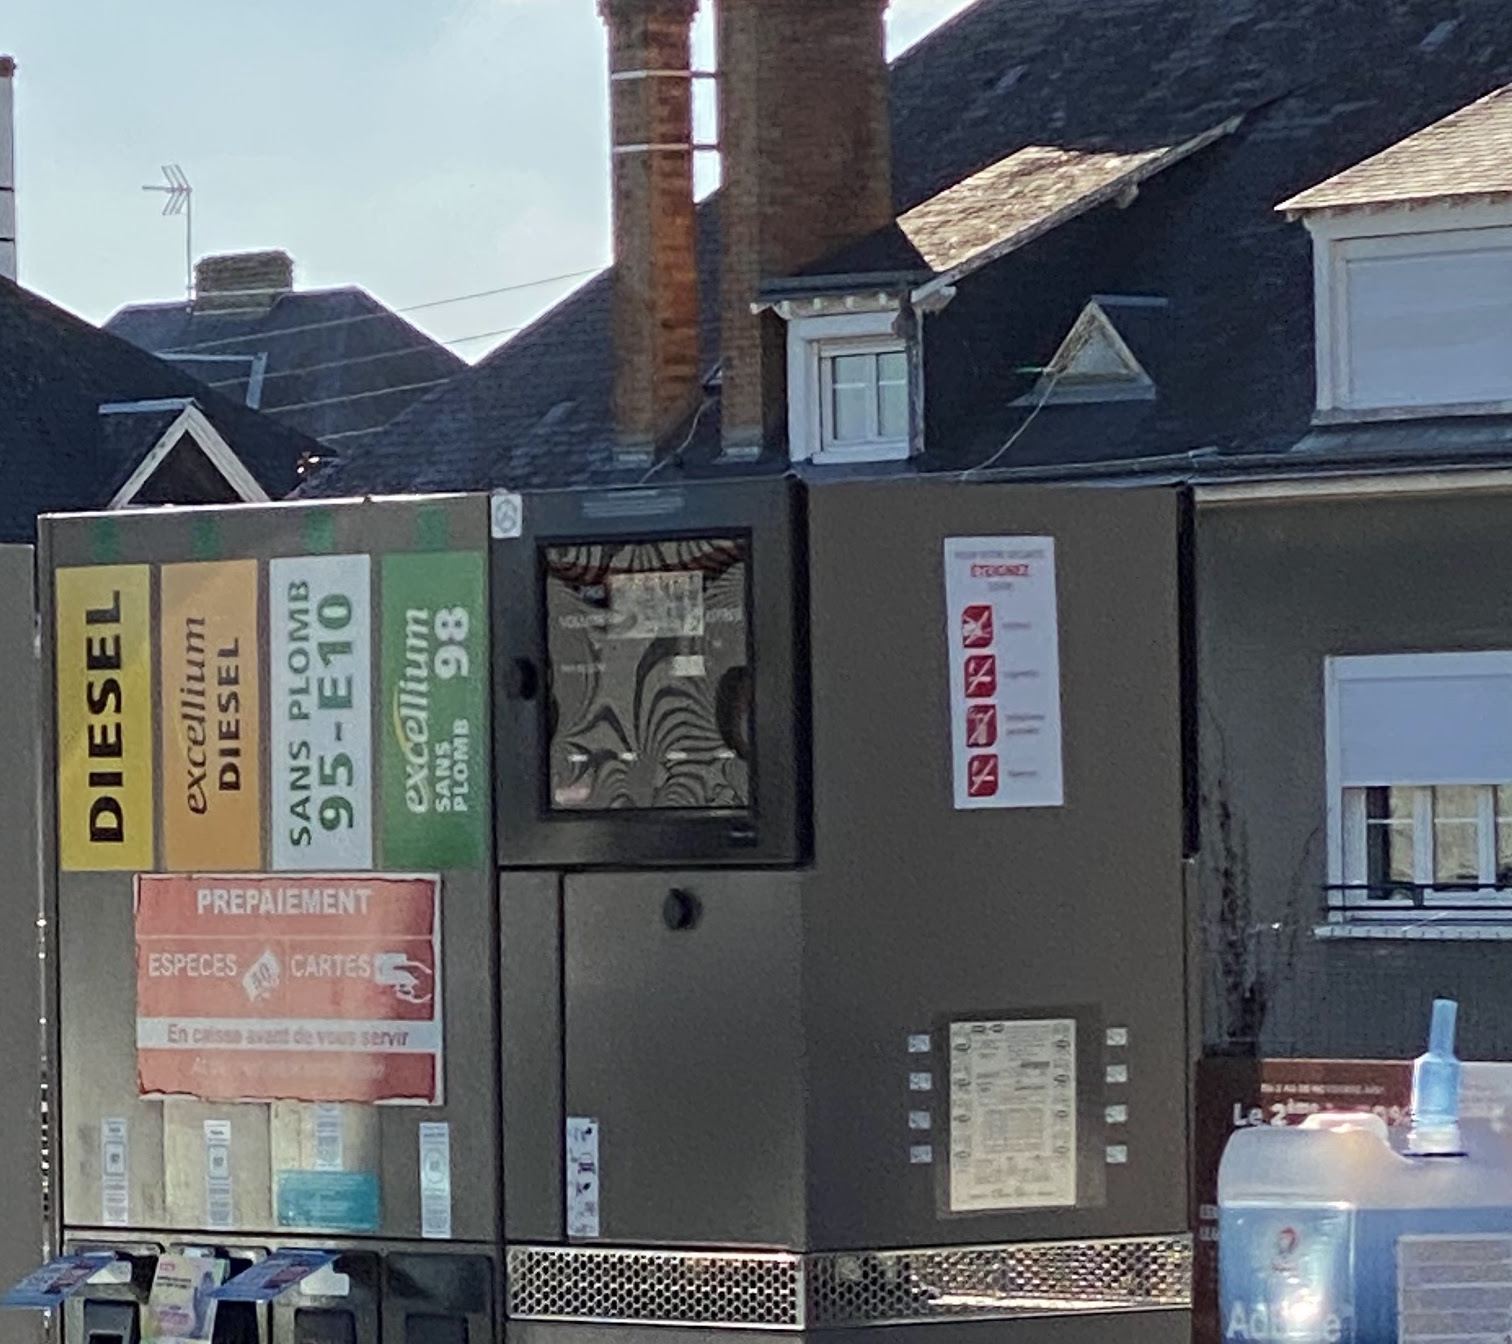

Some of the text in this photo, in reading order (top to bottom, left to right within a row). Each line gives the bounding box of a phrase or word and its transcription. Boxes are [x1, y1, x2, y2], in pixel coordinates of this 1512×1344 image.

[434, 605, 470, 679] 98
[86, 589, 125, 844] DIESEL
[180, 616, 208, 816] excellium
[216, 637, 242, 792] DIESEL
[288, 579, 312, 847] SANS PLOMB
[401, 607, 431, 814] excellium
[434, 740, 452, 812] SANS
[453, 717, 470, 812] PLOMB
[196, 887, 373, 916] PREPAIEMENT
[147, 953, 237, 977] ESPECES
[290, 954, 372, 978] CARTES
[167, 1023, 188, 1044] En
[294, 1024, 314, 1046] de
[360, 1027, 409, 1047] servir
[1233, 1102, 1264, 1126] Le
